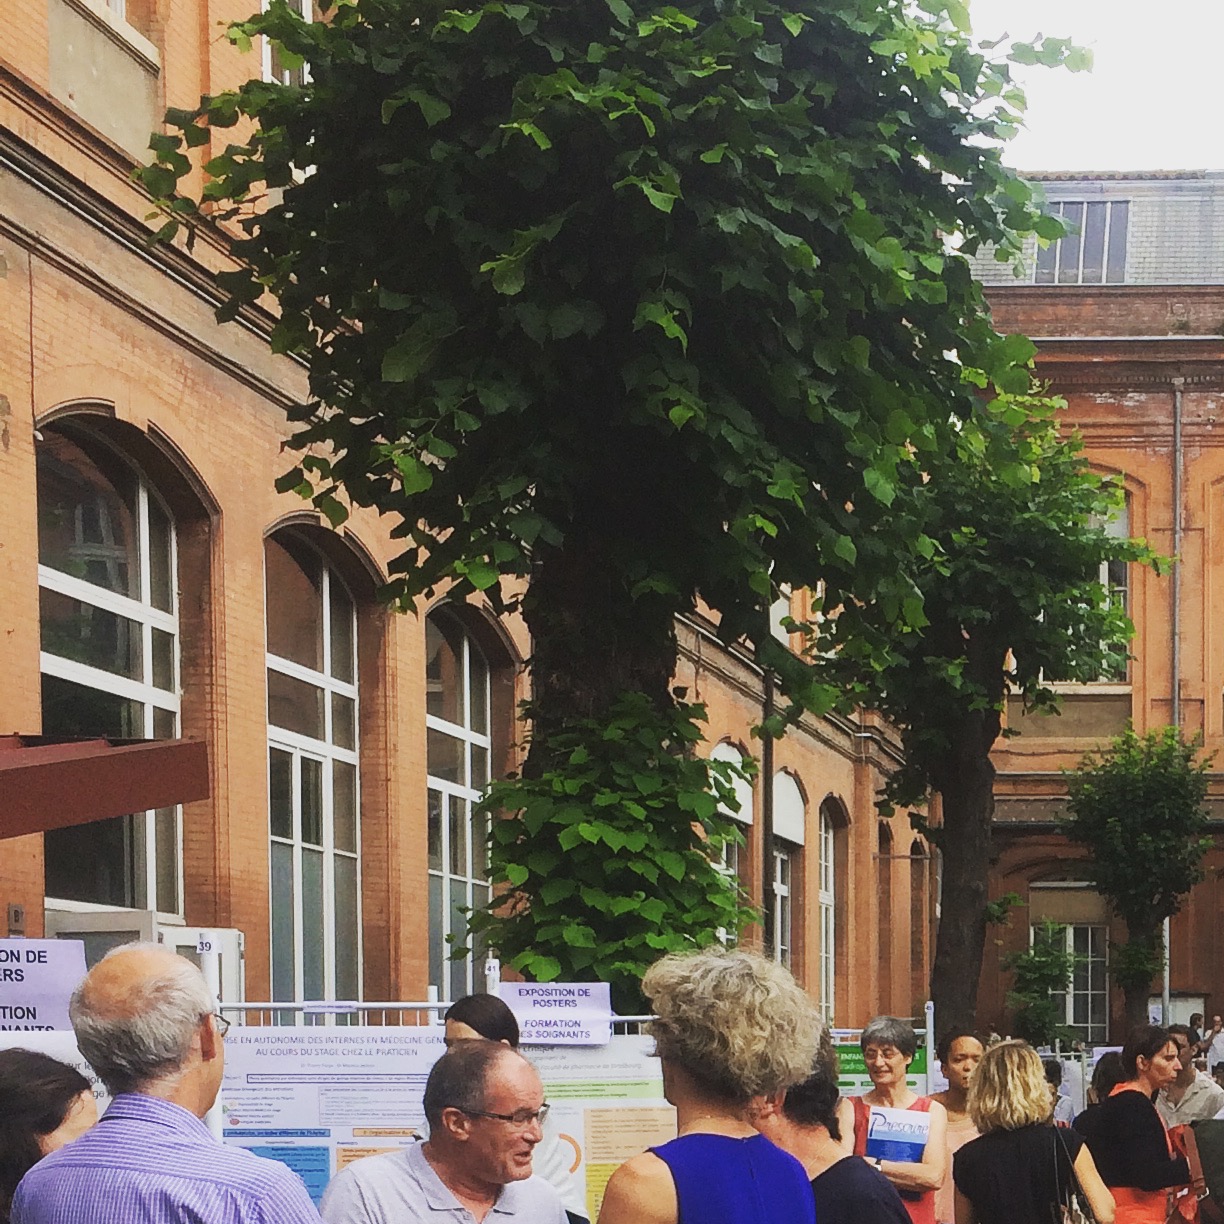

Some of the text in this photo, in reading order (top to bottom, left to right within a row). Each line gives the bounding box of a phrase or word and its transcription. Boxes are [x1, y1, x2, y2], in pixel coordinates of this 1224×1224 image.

[198, 941, 212, 952] 39
[26, 950, 48, 964] DE
[0, 969, 25, 982] RS
[518, 988, 591, 997] EXPOSITION DE
[532, 999, 577, 1008] POSTERS
[524, 1020, 581, 1028] FORMATION
[519, 1030, 591, 1039] ES SOIGNANTS
